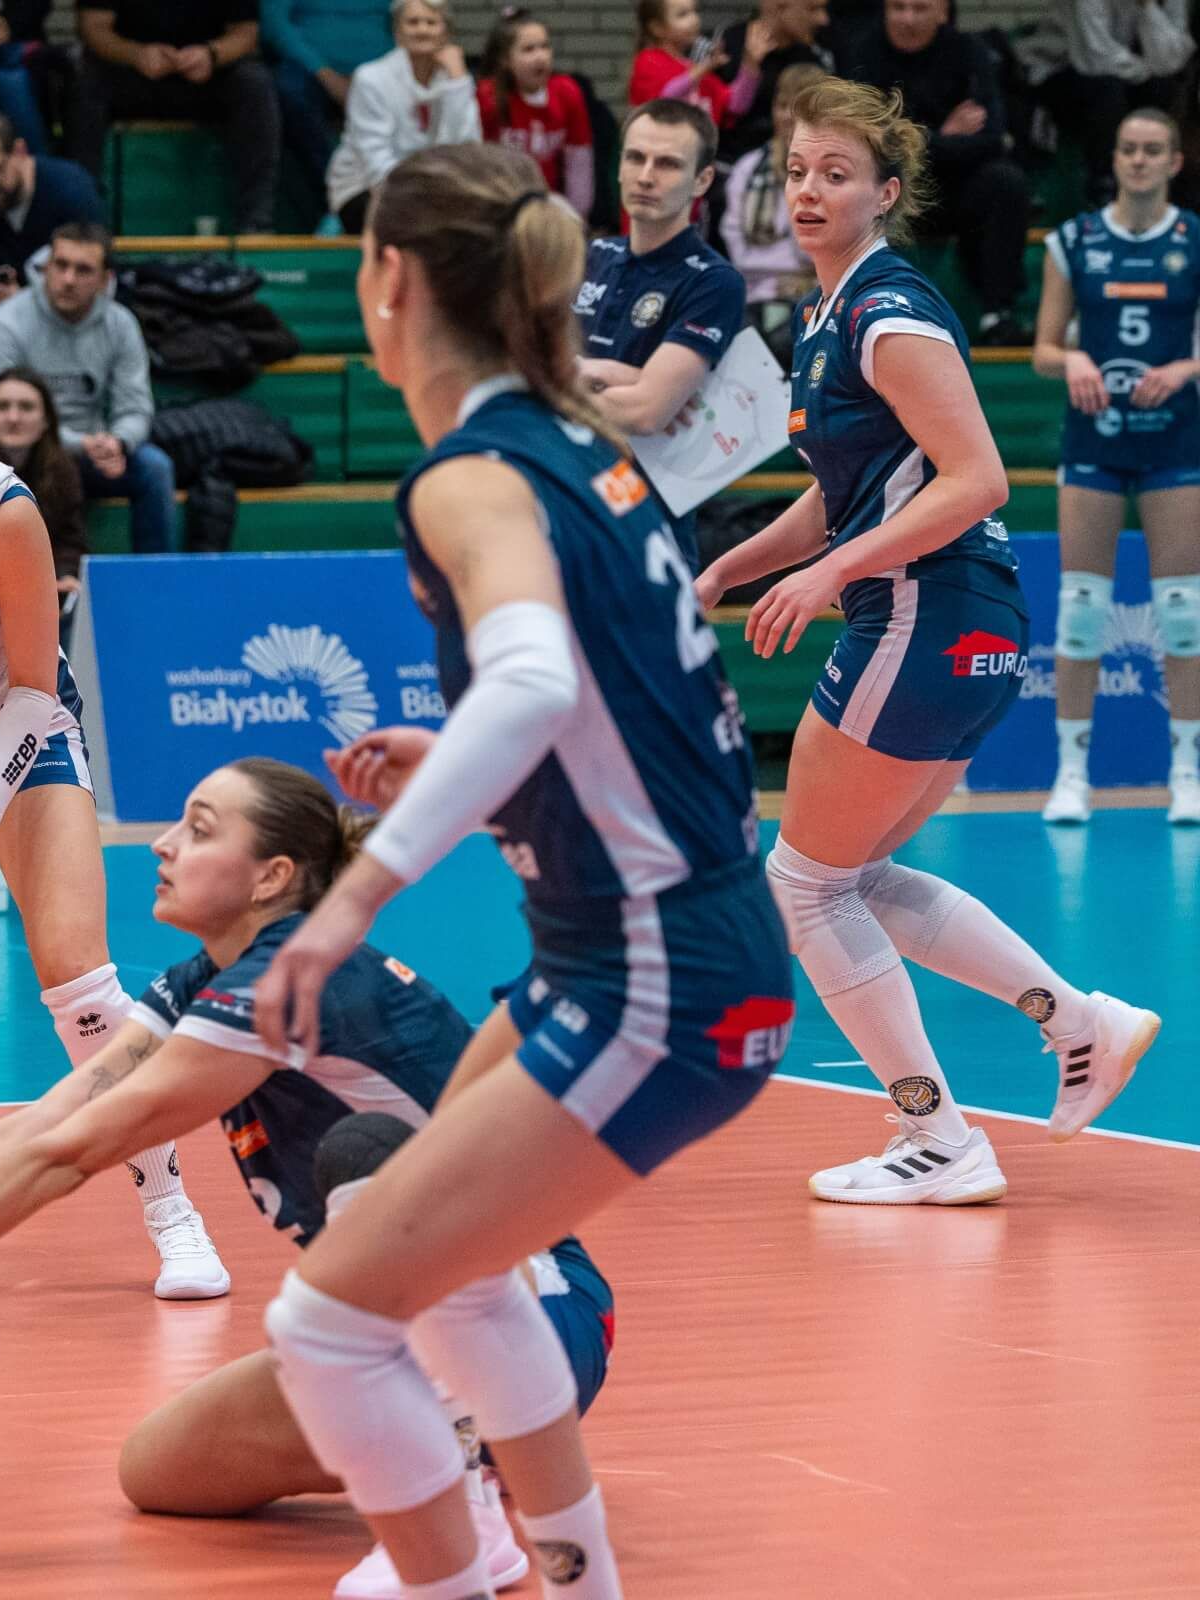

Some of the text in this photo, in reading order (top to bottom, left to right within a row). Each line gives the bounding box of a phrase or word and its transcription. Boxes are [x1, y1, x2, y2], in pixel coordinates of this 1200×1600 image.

[1117, 305, 1151, 346] 5
[16, 733, 38, 771] cep
[743, 1023, 791, 1069] EU
